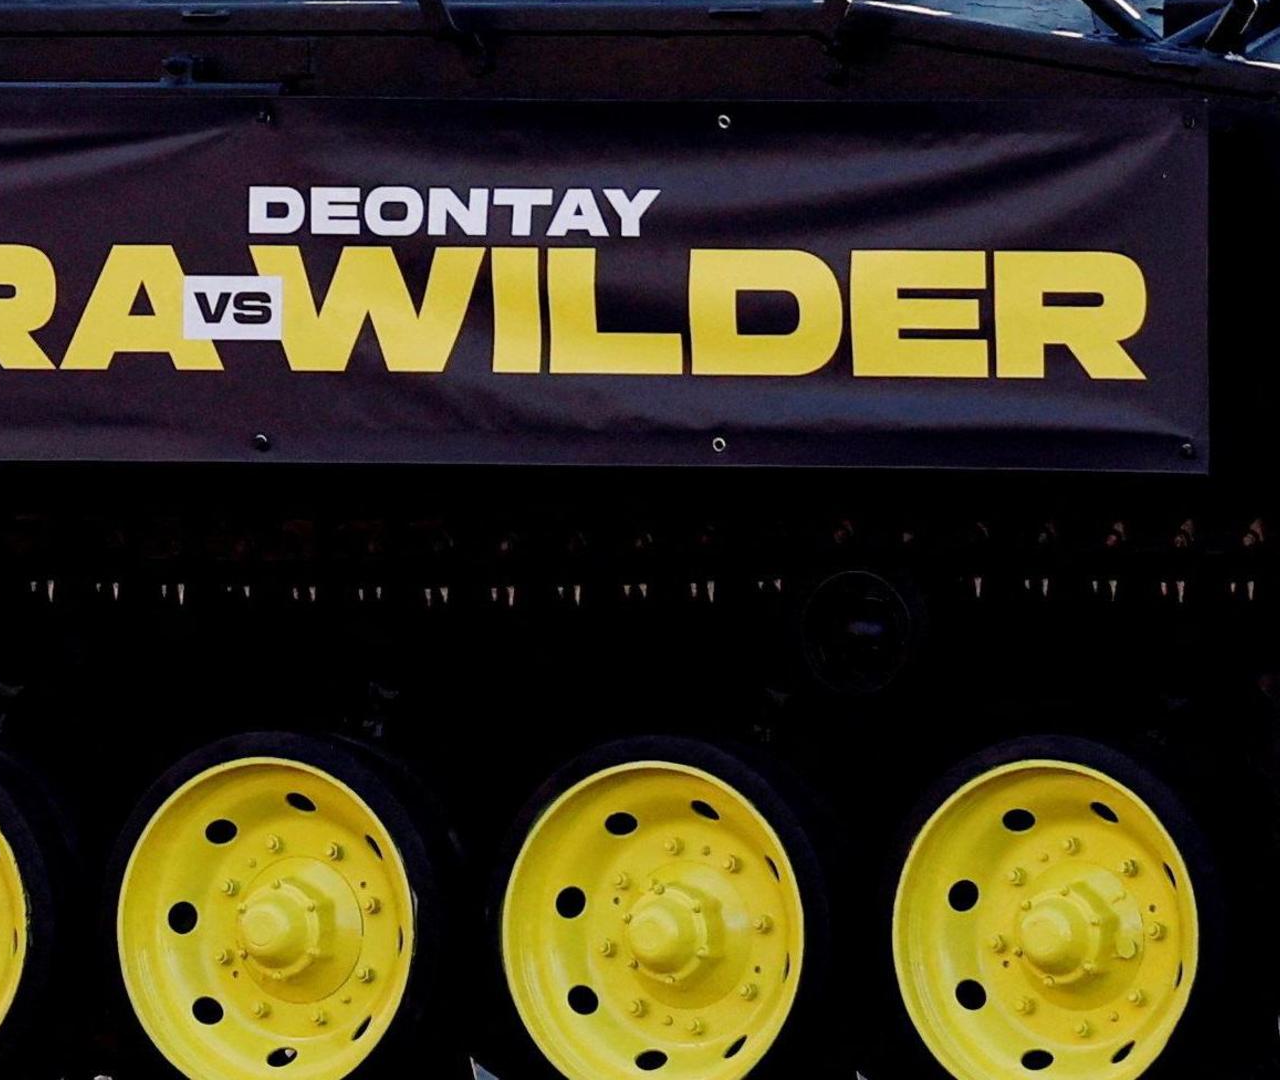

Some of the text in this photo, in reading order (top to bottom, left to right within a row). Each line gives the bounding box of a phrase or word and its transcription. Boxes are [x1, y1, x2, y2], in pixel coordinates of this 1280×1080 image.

[248, 186, 662, 238] DEONTAY
[194, 291, 273, 324] VS
[249, 245, 1149, 380] WILDER
